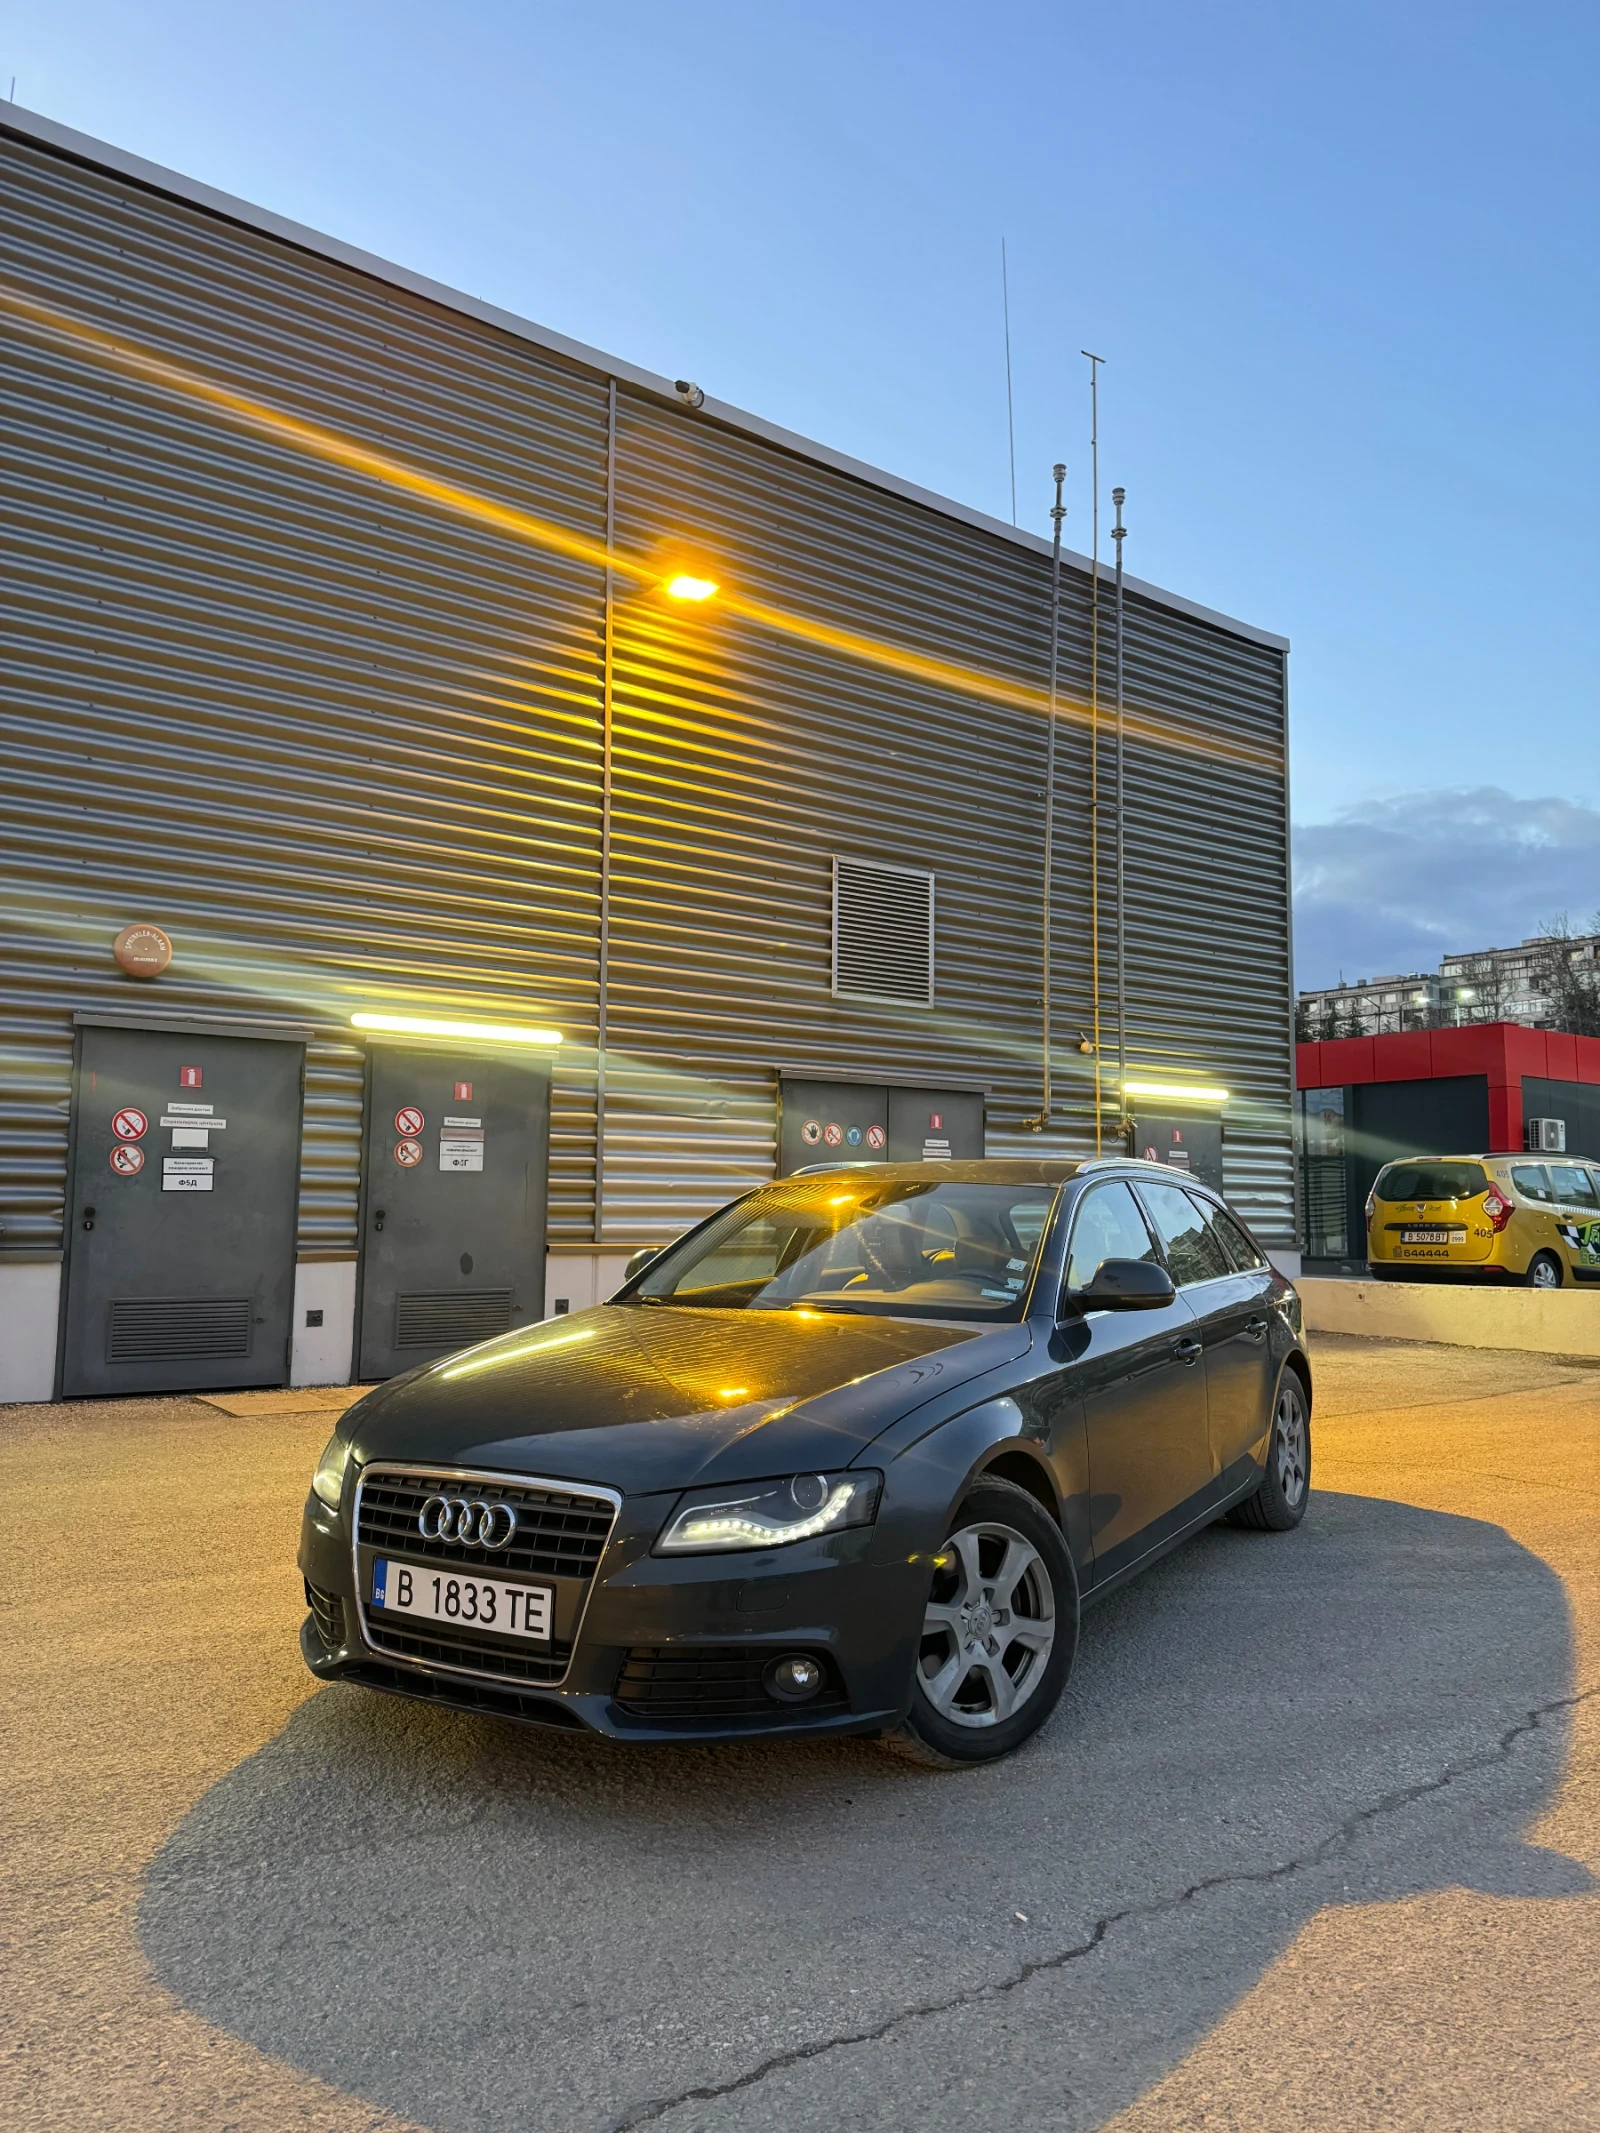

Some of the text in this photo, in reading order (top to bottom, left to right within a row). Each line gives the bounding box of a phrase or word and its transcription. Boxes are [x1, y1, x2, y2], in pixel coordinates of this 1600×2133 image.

[1496, 1169, 1510, 1179] 405
[178, 1179, 197, 1187] Ф5Д
[1474, 1228, 1494, 1239] 405
[1403, 1249, 1450, 1258] 644444
[375, 1588, 385, 1600] BG
[397, 1569, 545, 1634] B 1833 TE
